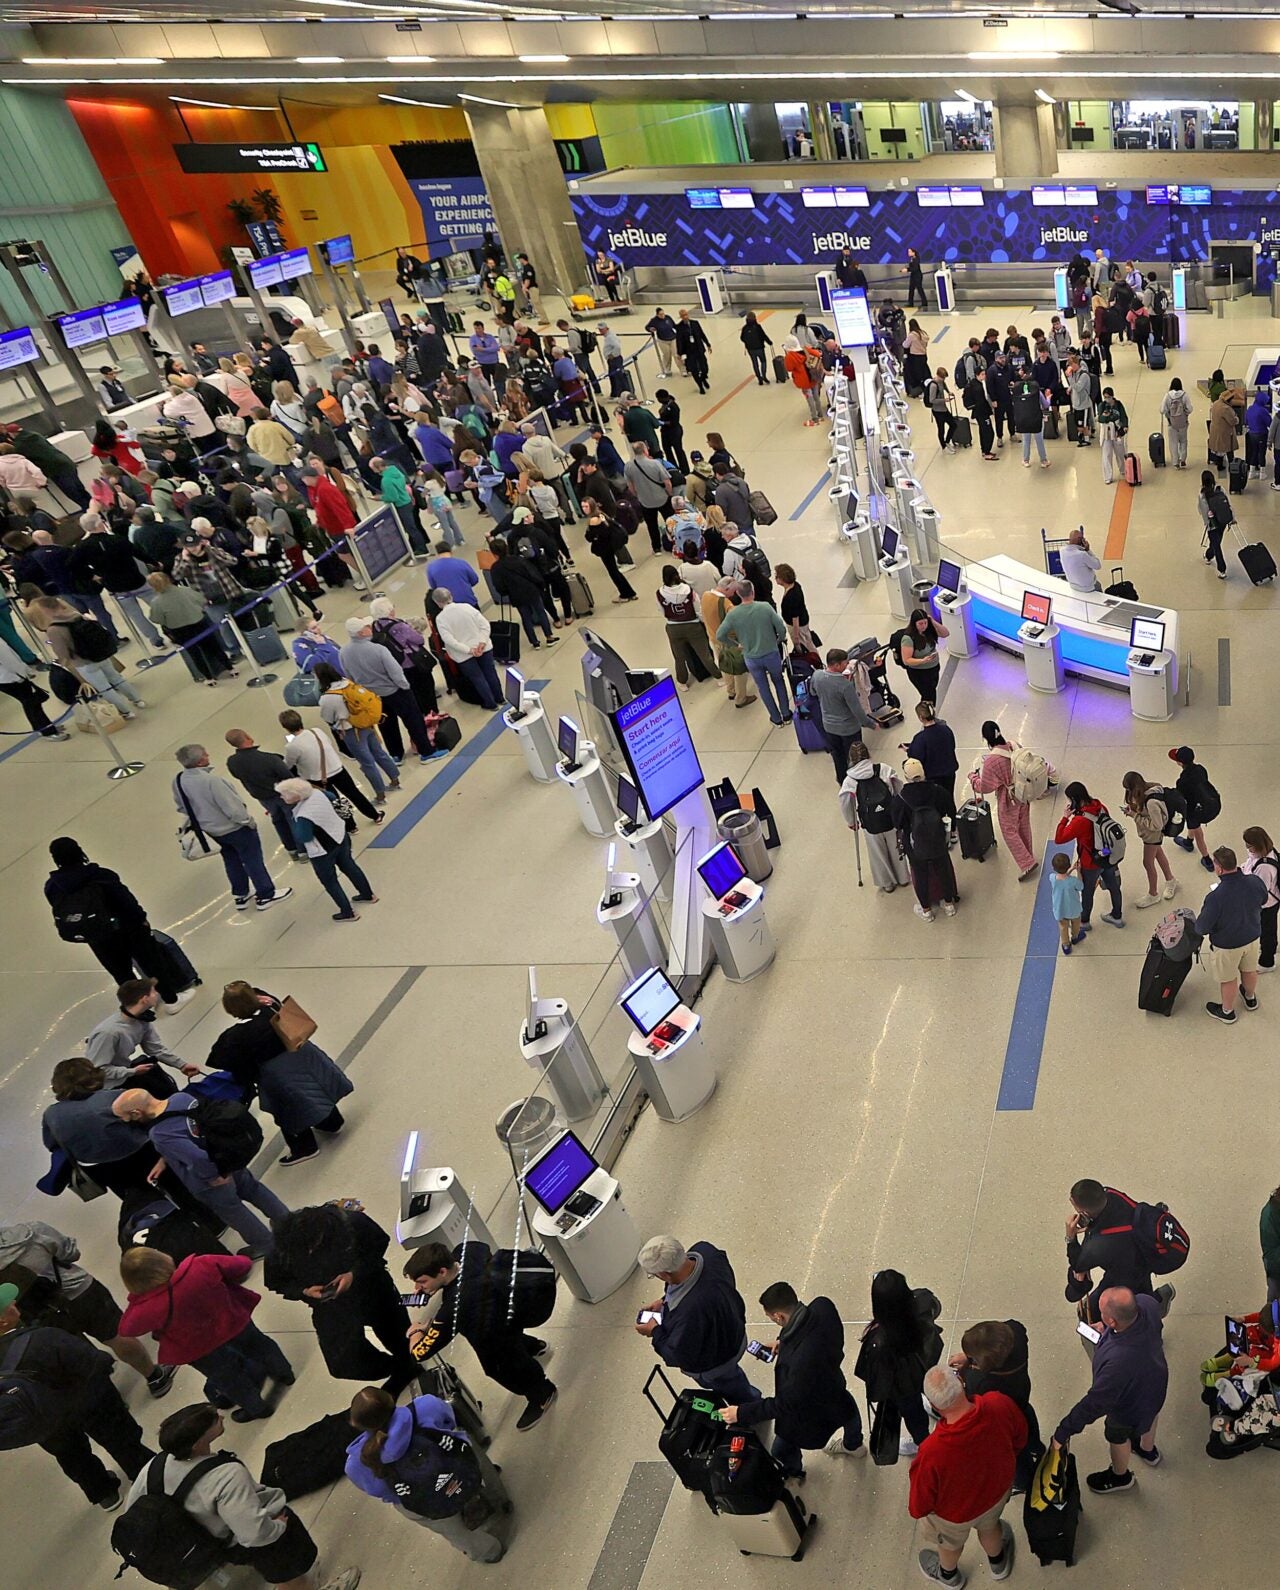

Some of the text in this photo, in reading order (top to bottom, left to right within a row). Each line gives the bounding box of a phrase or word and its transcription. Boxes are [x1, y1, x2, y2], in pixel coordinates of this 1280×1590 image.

[429, 196, 459, 207] YOUR
[435, 209, 495, 222] EXPERIENC
[439, 224, 483, 235] GETTING
[1040, 227, 1088, 246] jetBlue
[608, 229, 667, 252] jetBlue
[812, 232, 871, 254] jetBlue
[621, 696, 651, 725] jetBlue
[628, 711, 667, 742] Start here
